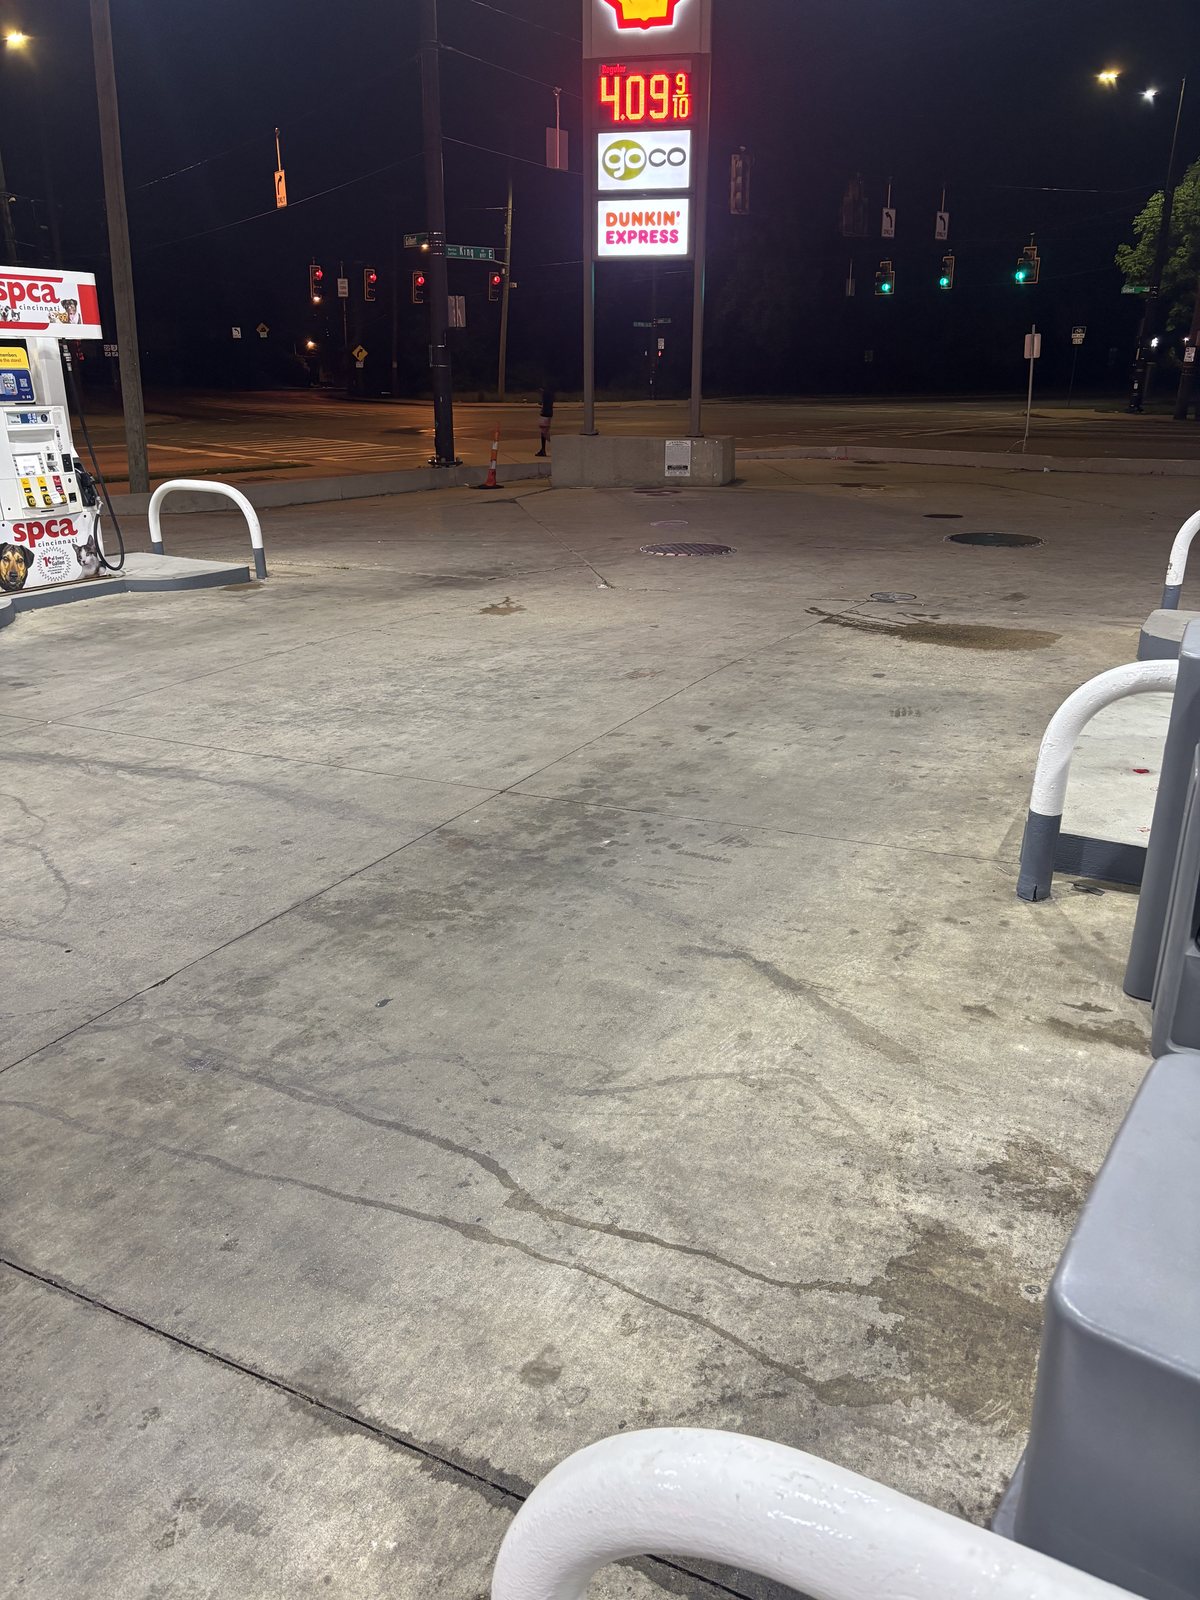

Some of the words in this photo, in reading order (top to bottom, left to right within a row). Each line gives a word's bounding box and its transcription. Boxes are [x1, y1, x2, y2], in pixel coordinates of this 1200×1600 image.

[605, 210, 681, 227] DUNKIN'
[605, 229, 679, 245] EXPRESS
[459, 246, 474, 259] King
[488, 249, 493, 259] E
[19, 304, 60, 312] cincinnati
[12, 518, 79, 548] spca
[37, 537, 78, 547] cincinnati
